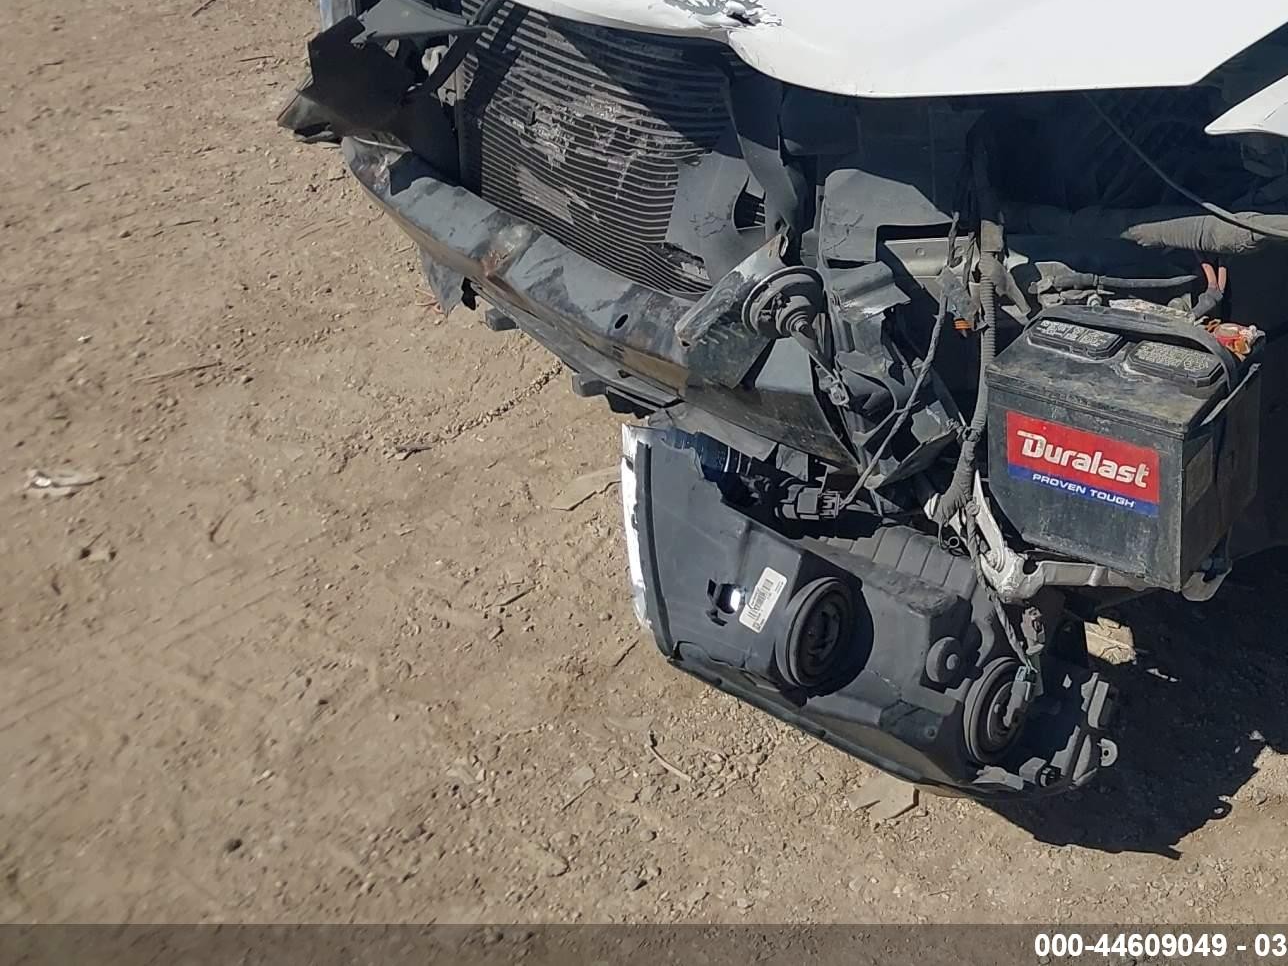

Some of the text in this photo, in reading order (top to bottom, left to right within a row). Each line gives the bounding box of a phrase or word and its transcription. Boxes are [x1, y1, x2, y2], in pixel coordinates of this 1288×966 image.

[1017, 430, 1151, 490] Duralast
[1032, 473, 1136, 509] PROVEN TOUGH
